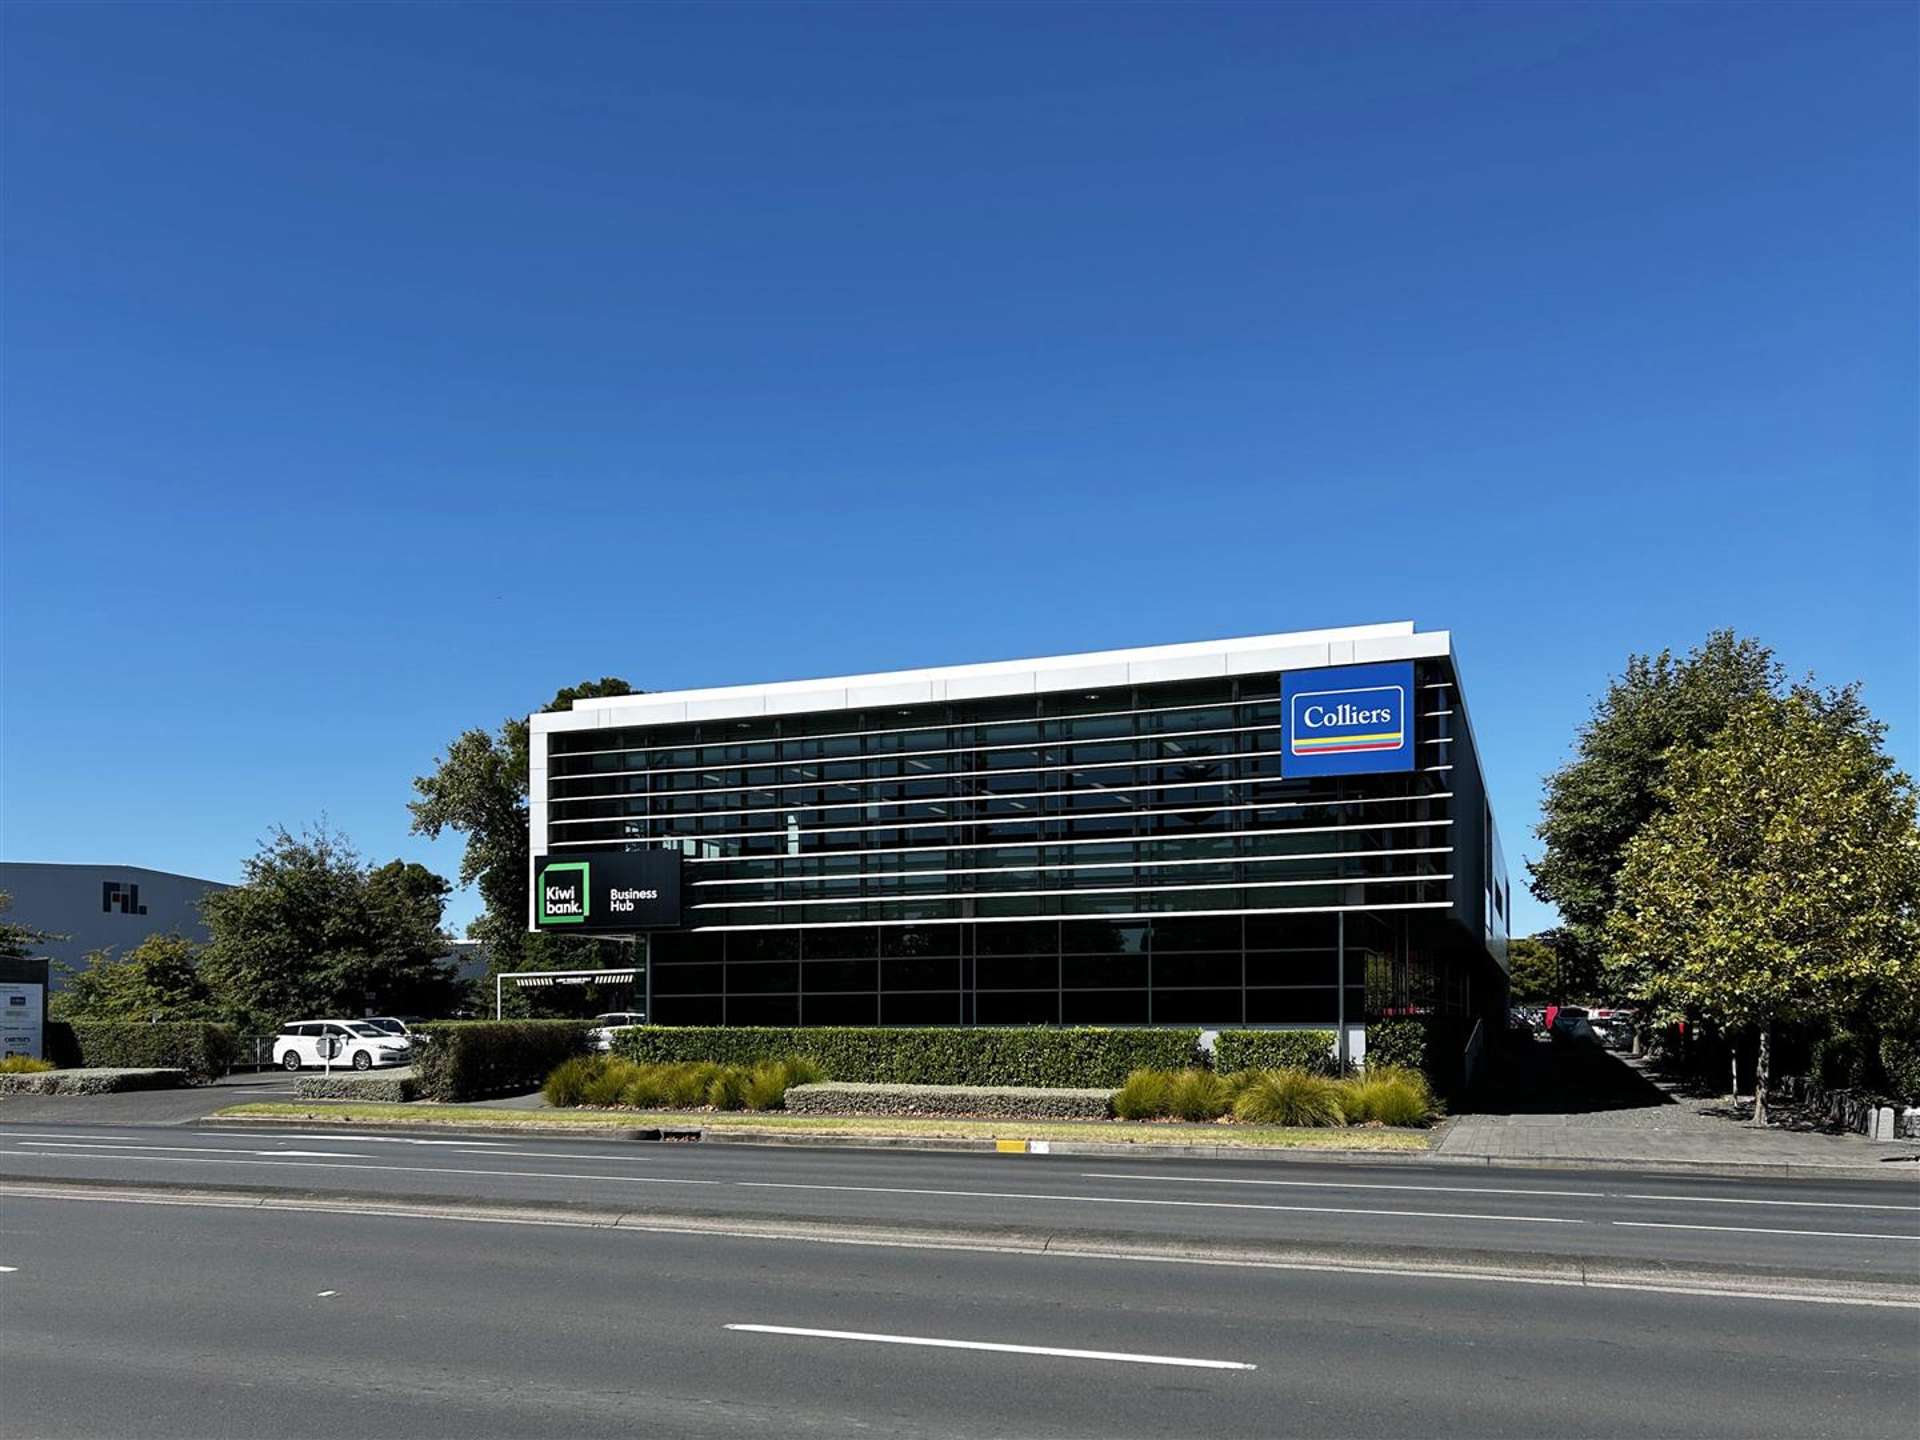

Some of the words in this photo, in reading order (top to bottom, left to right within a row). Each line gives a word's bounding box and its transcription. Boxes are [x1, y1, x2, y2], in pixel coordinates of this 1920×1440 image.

[1304, 703, 1391, 728] Colliers
[546, 885, 575, 900] Kiwi
[610, 888, 657, 900] Business
[546, 900, 582, 914] bank.
[610, 900, 634, 912] Hub
